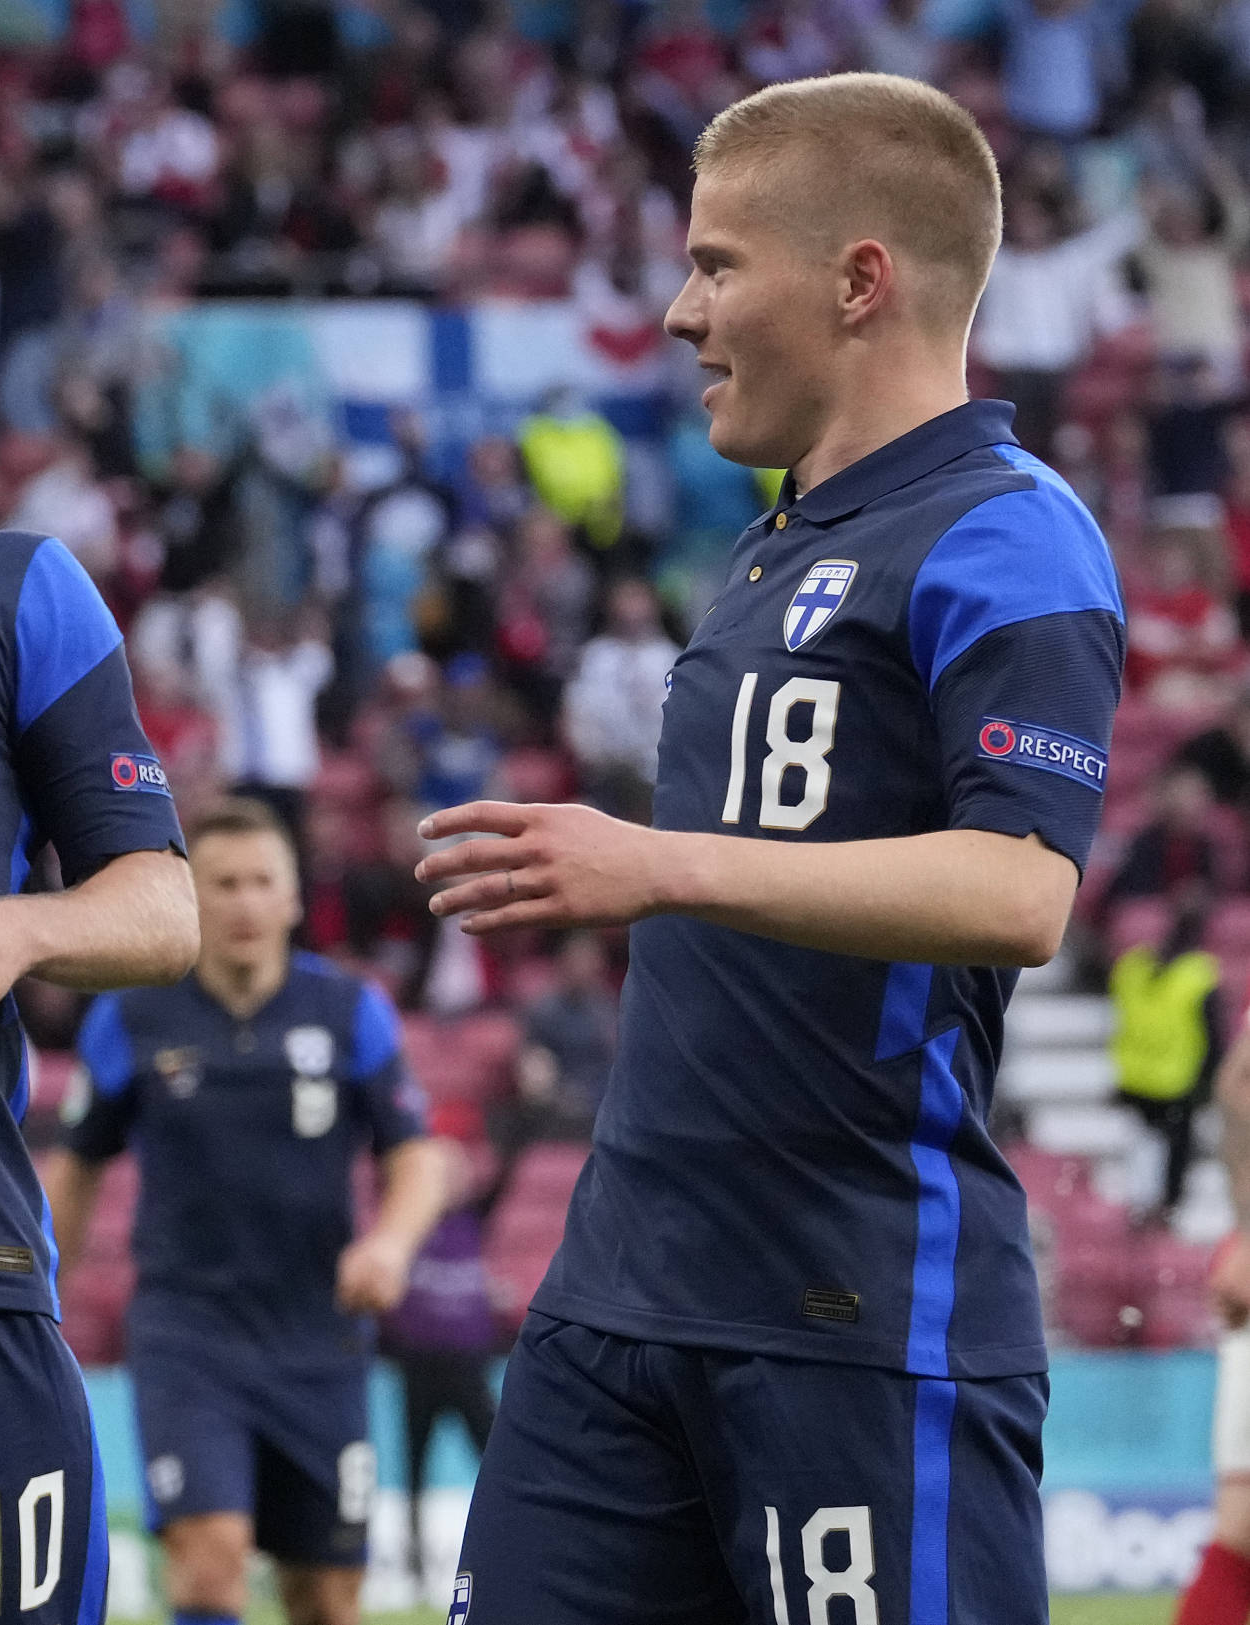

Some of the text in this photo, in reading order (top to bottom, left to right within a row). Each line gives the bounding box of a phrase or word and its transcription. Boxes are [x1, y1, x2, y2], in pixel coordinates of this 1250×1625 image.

[721, 672, 842, 831] 18
[1019, 734, 1107, 779] RESPECT
[764, 1505, 883, 1625] 18
